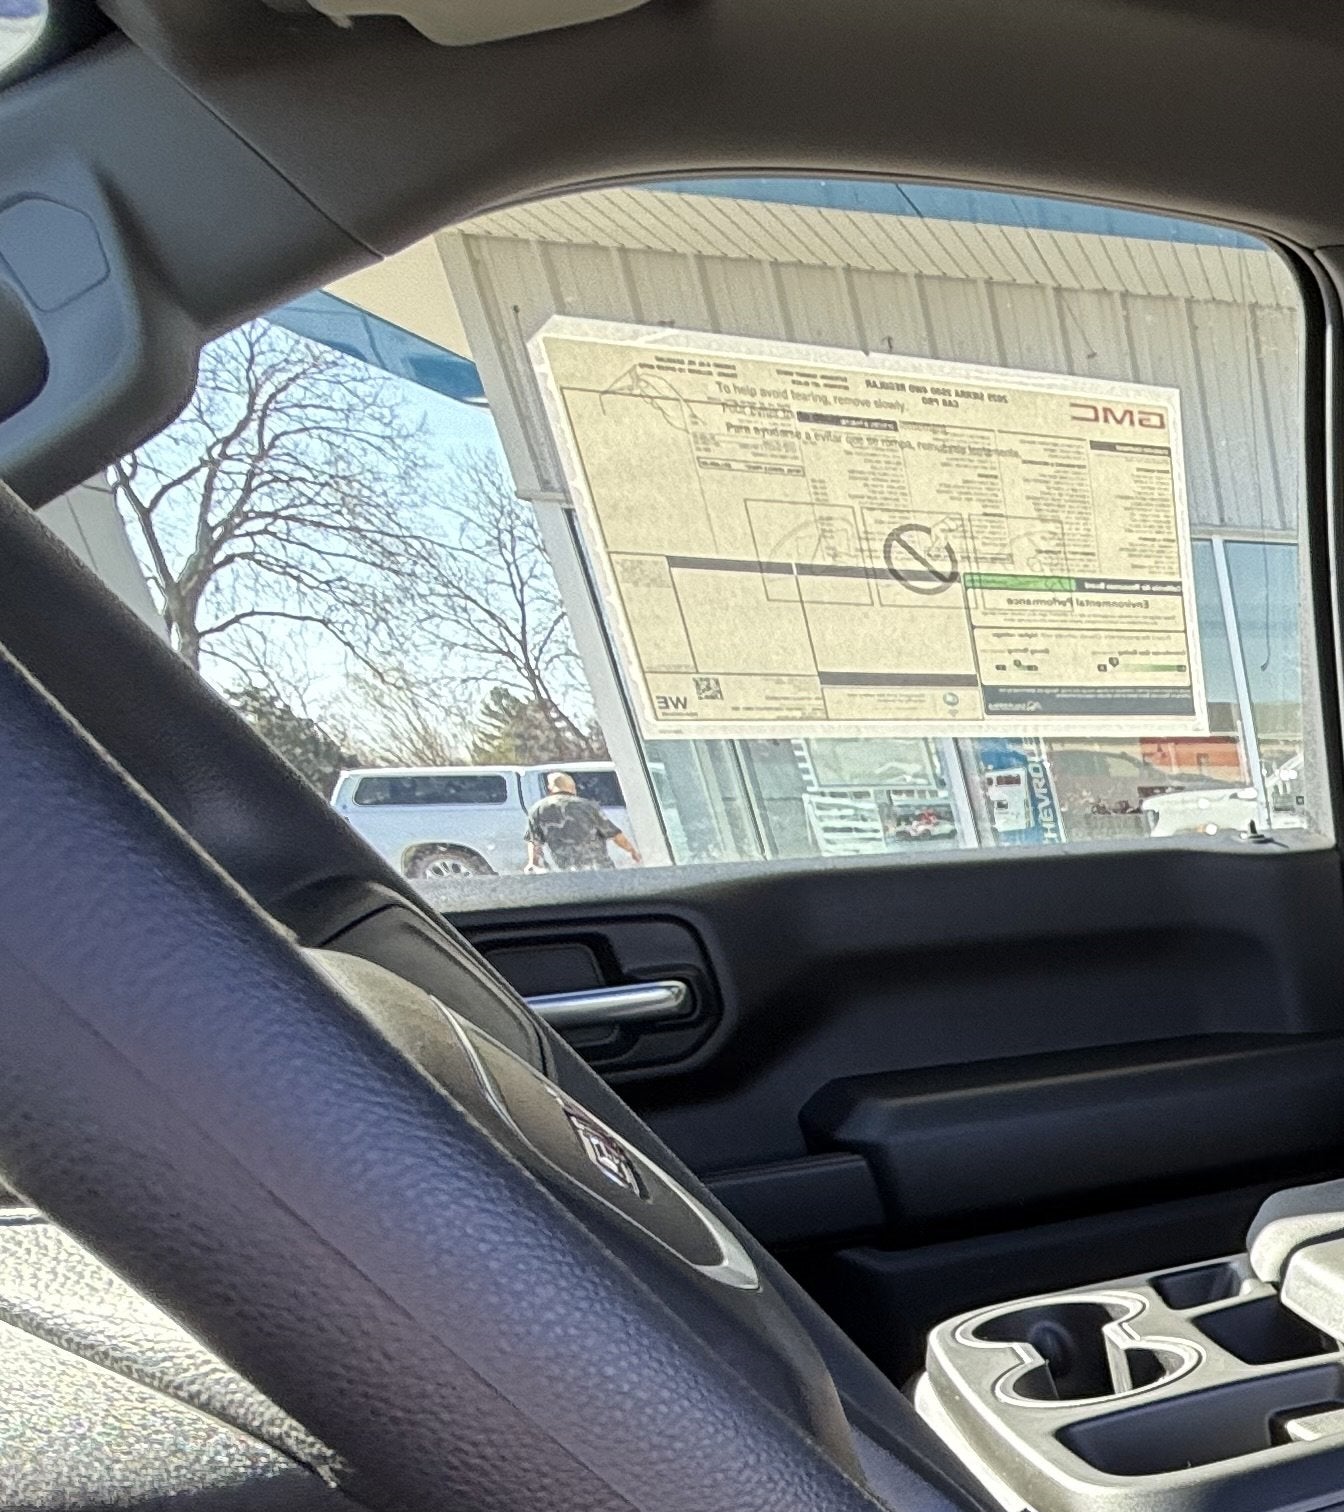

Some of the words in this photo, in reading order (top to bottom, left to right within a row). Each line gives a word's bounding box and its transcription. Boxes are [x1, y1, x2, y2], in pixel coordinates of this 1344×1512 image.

[715, 381, 732, 396] To
[733, 383, 758, 399] help
[760, 385, 789, 401] avoid
[790, 388, 831, 407] tearing,
[833, 393, 873, 409] remove
[726, 422, 752, 437] Para
